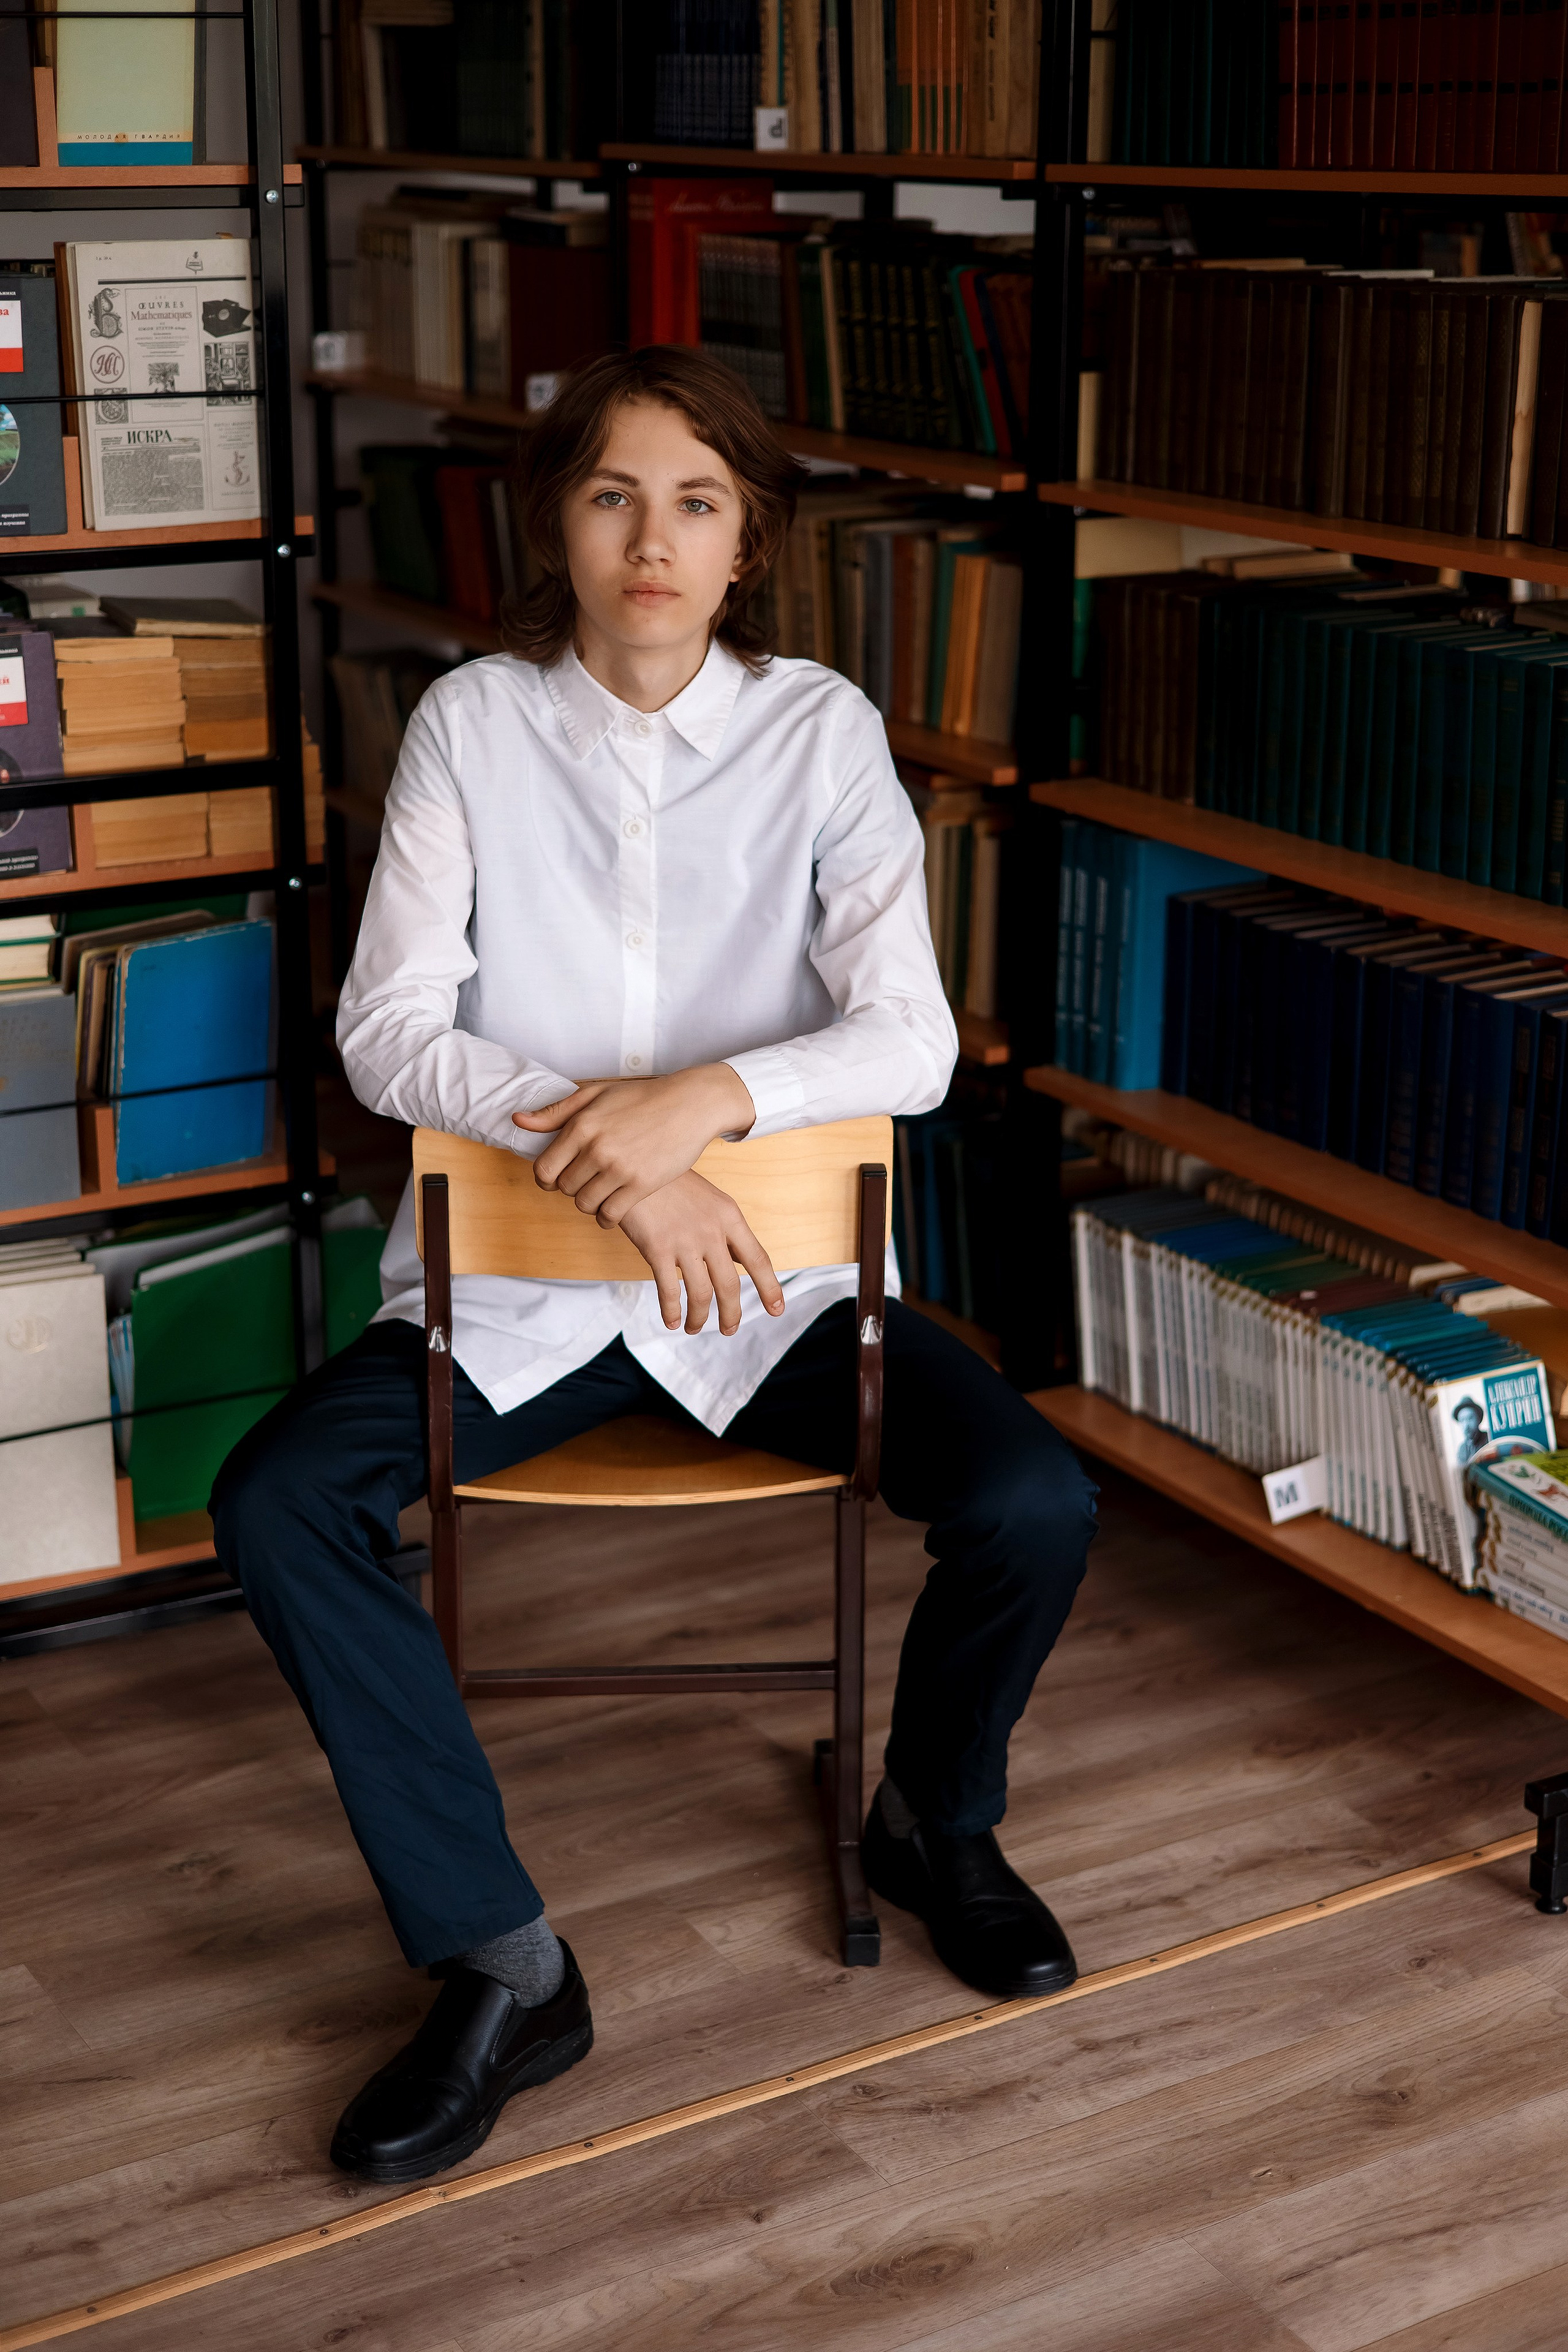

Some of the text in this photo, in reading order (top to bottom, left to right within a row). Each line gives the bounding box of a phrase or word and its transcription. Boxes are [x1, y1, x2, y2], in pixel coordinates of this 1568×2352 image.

[130, 311, 192, 322] Mathematiques
[127, 429, 173, 444] ИСКРА
[1490, 1393, 1542, 1433] КУПРИН
[1274, 1480, 1298, 1508] М
